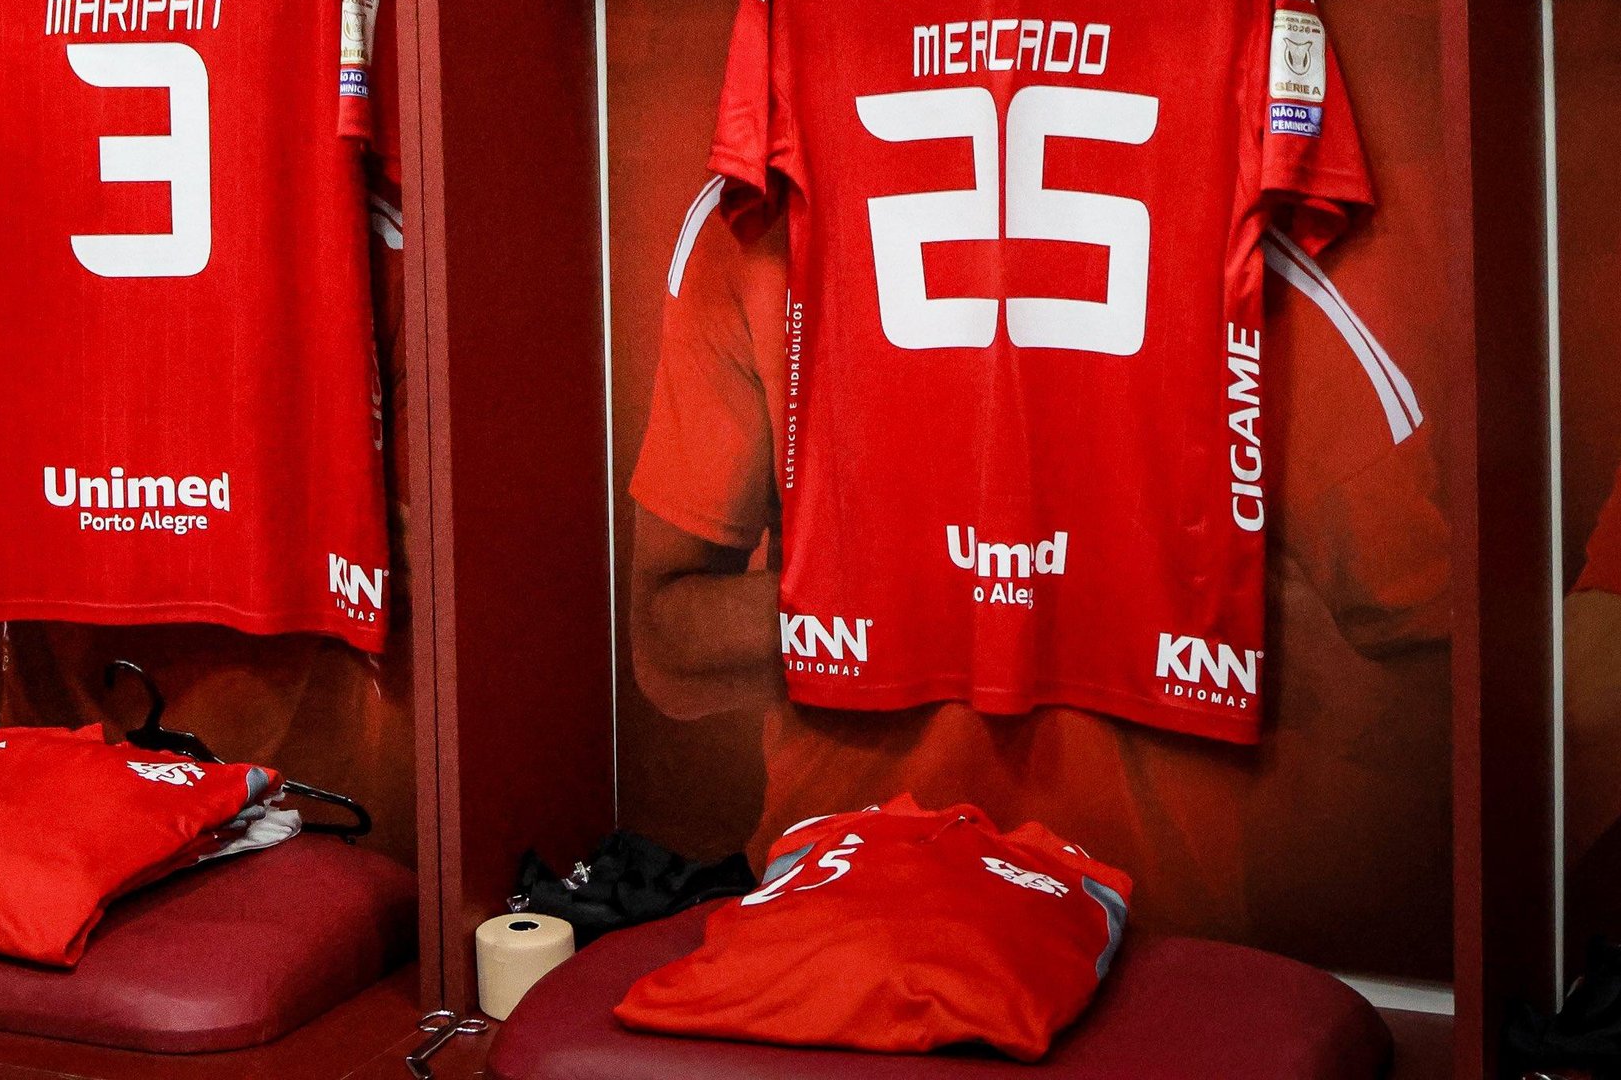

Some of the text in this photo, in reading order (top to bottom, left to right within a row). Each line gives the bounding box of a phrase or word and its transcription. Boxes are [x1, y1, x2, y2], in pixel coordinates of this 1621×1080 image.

[913, 18, 1111, 77] MERCADO
[1275, 80, 1322, 96] SÉRIE A
[1294, 108, 1307, 120] AO
[66, 42, 212, 278] 3
[855, 85, 1159, 356] 25
[1227, 322, 1265, 532] CIGAME
[44, 466, 230, 512] Unimed
[80, 510, 208, 535] Porto Alegre
[779, 611, 868, 662] KNN
[788, 660, 860, 676] IDIOMAS
[1155, 632, 1257, 695] KNN
[1164, 683, 1247, 709] IDIOMAS
